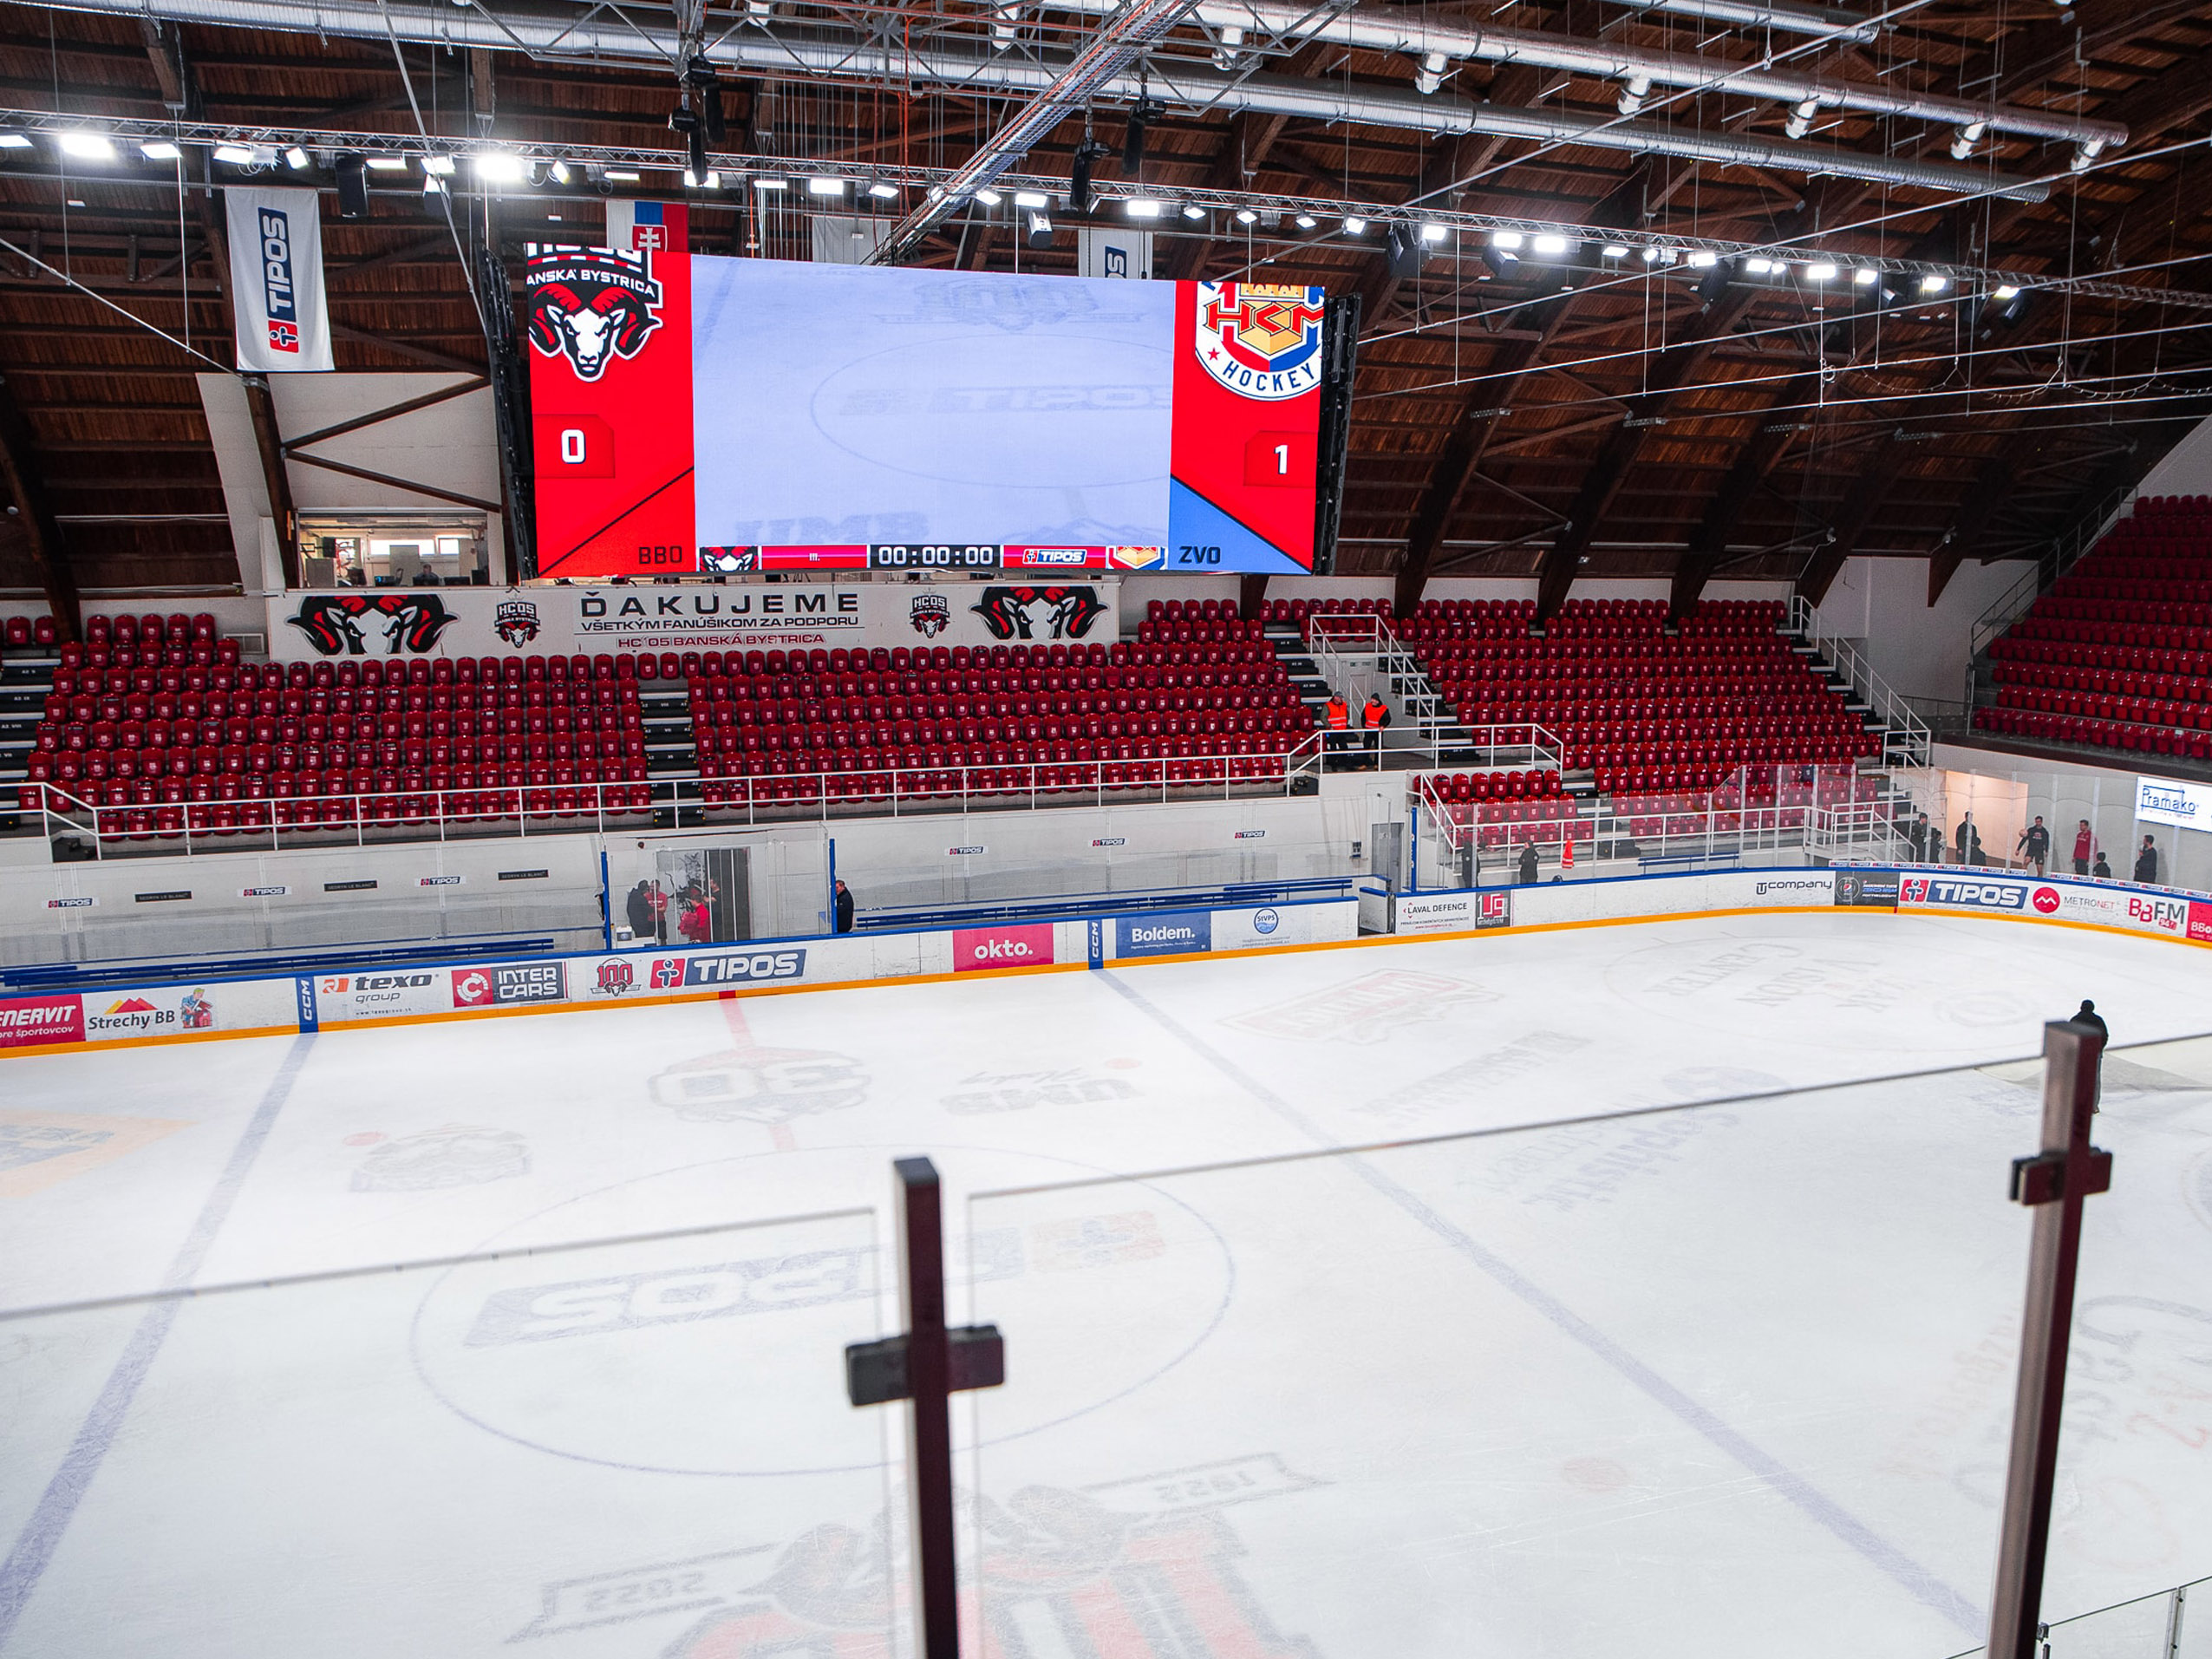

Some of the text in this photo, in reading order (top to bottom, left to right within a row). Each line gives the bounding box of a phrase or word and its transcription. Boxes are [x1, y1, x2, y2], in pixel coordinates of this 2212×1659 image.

[262, 214, 292, 313] TIPOS
[580, 270, 656, 298] BYSTRICA
[1222, 360, 1315, 392] HOCKEY
[561, 429, 585, 464] 0
[1272, 444, 1289, 475] 1
[878, 546, 995, 565] 00:00:00
[1040, 550, 1084, 564] TIPOS
[581, 591, 858, 617] ĎAKUJEME
[581, 616, 858, 631] VŠETKÝM FANÚŠIKOM ZA PODPORU
[673, 633, 743, 646] BANSKÁ
[746, 634, 825, 645] BYSTRICA
[2141, 787, 2196, 813] Pramako
[1101, 838, 1125, 846] TIPOS
[1243, 830, 1265, 839] TIPOS
[958, 846, 983, 855] TIPOS
[431, 876, 460, 885] TIPOS
[253, 887, 285, 896] TIPOS
[1935, 883, 2022, 906] TIPOS
[58, 898, 91, 907] TIPOS
[1407, 902, 1468, 914] LAVAL DEFENCE
[2064, 896, 2116, 909] METRONET
[1131, 926, 1196, 944] Boldem.
[974, 939, 1034, 960] okto.
[498, 966, 558, 983] INTER
[693, 952, 799, 982] TIPOS
[355, 974, 433, 991] texo
[498, 980, 558, 998] CARS
[303, 979, 315, 1022] CCM
[356, 992, 401, 1004] group
[88, 1010, 175, 1029] Strechy BB
[16, 1025, 75, 1039] športovcov
